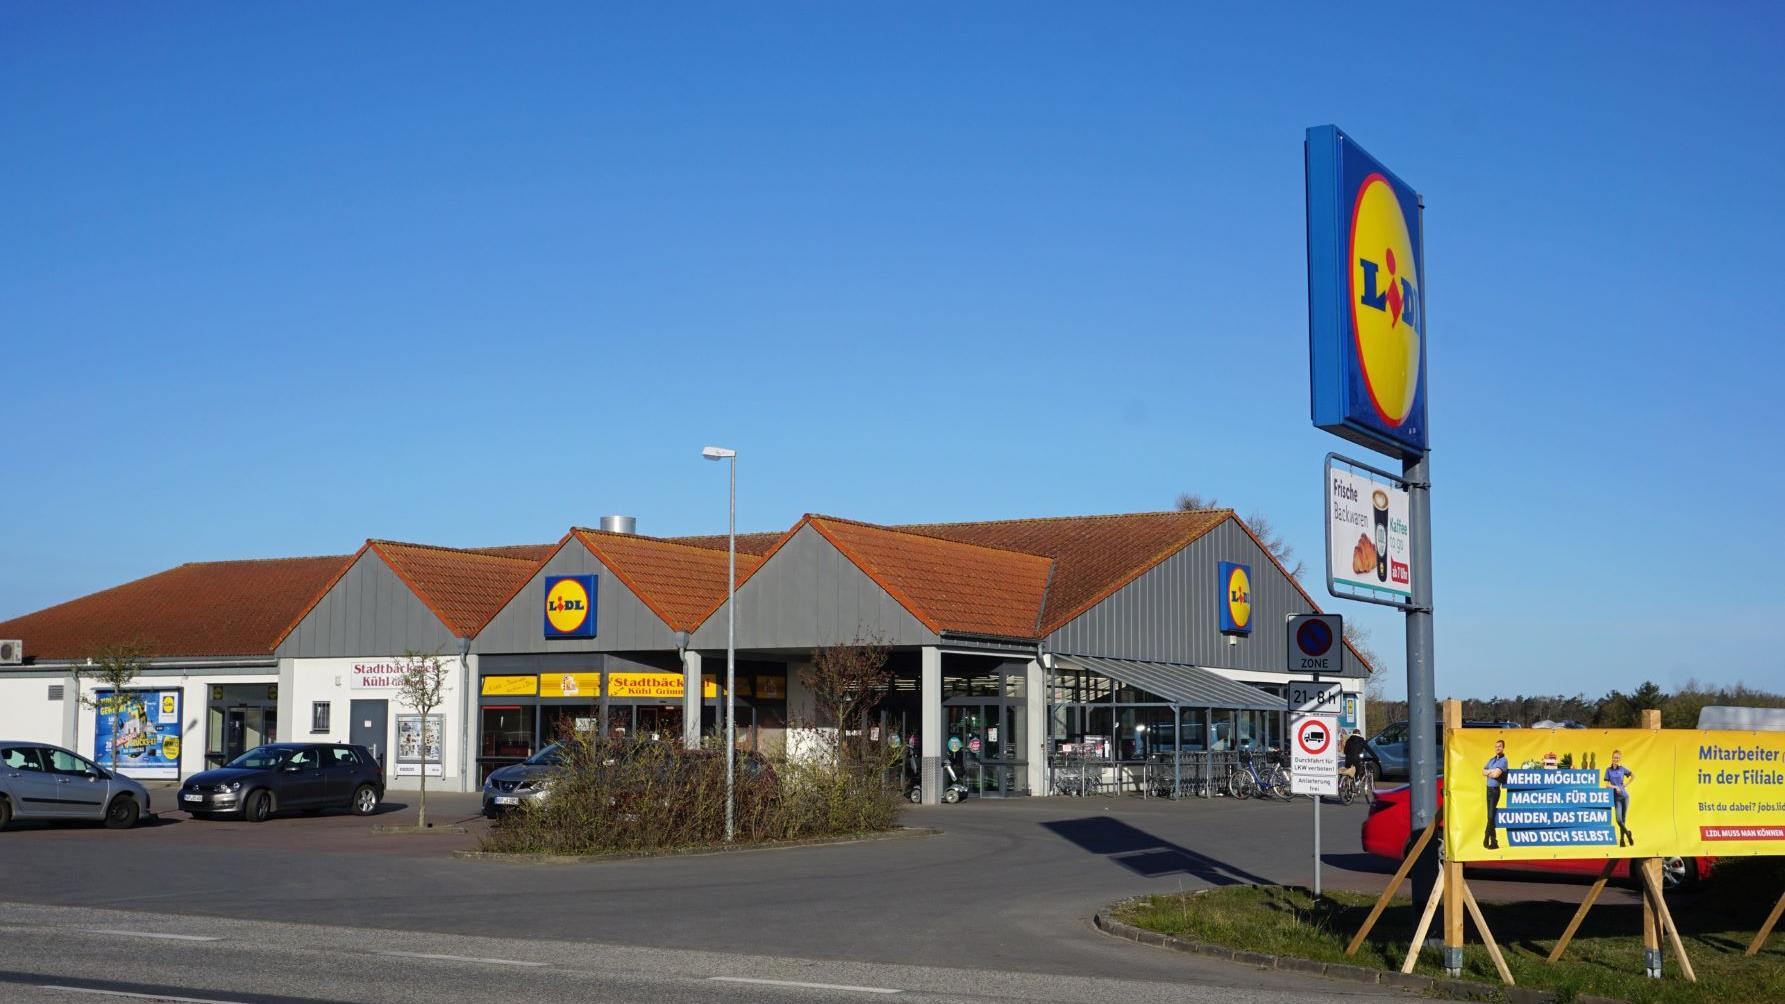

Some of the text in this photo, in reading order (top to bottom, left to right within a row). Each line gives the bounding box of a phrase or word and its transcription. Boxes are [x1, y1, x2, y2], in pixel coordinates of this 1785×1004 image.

[1334, 478, 1358, 502] Frische
[1334, 502, 1368, 528] Backwaren
[1390, 517, 1408, 535] Kaffee
[1301, 659, 1328, 669] ZONE
[362, 676, 390, 687] Kühl
[628, 687, 651, 695] Kühl
[1328, 691, 1336, 704] h
[1699, 745, 1780, 761] Mitarbeiter
[1294, 757, 1324, 765] Durchfahrt
[1507, 771, 1596, 785] MEHR MÖGLICH
[1698, 768, 1784, 785] in der Filiale
[1511, 790, 1610, 804] MACHEN. FÜR DIE
[1698, 802, 1715, 811] Bist
[1717, 802, 1727, 811] du
[1729, 802, 1756, 811] dabei?
[1498, 811, 1608, 825] KUNDEN, DAS TEAM
[1512, 830, 1613, 843] UND DICH SELBST.
[1705, 829, 1721, 837] LIDL
[1721, 829, 1740, 837] MUSS
[1741, 829, 1756, 837] MAN
